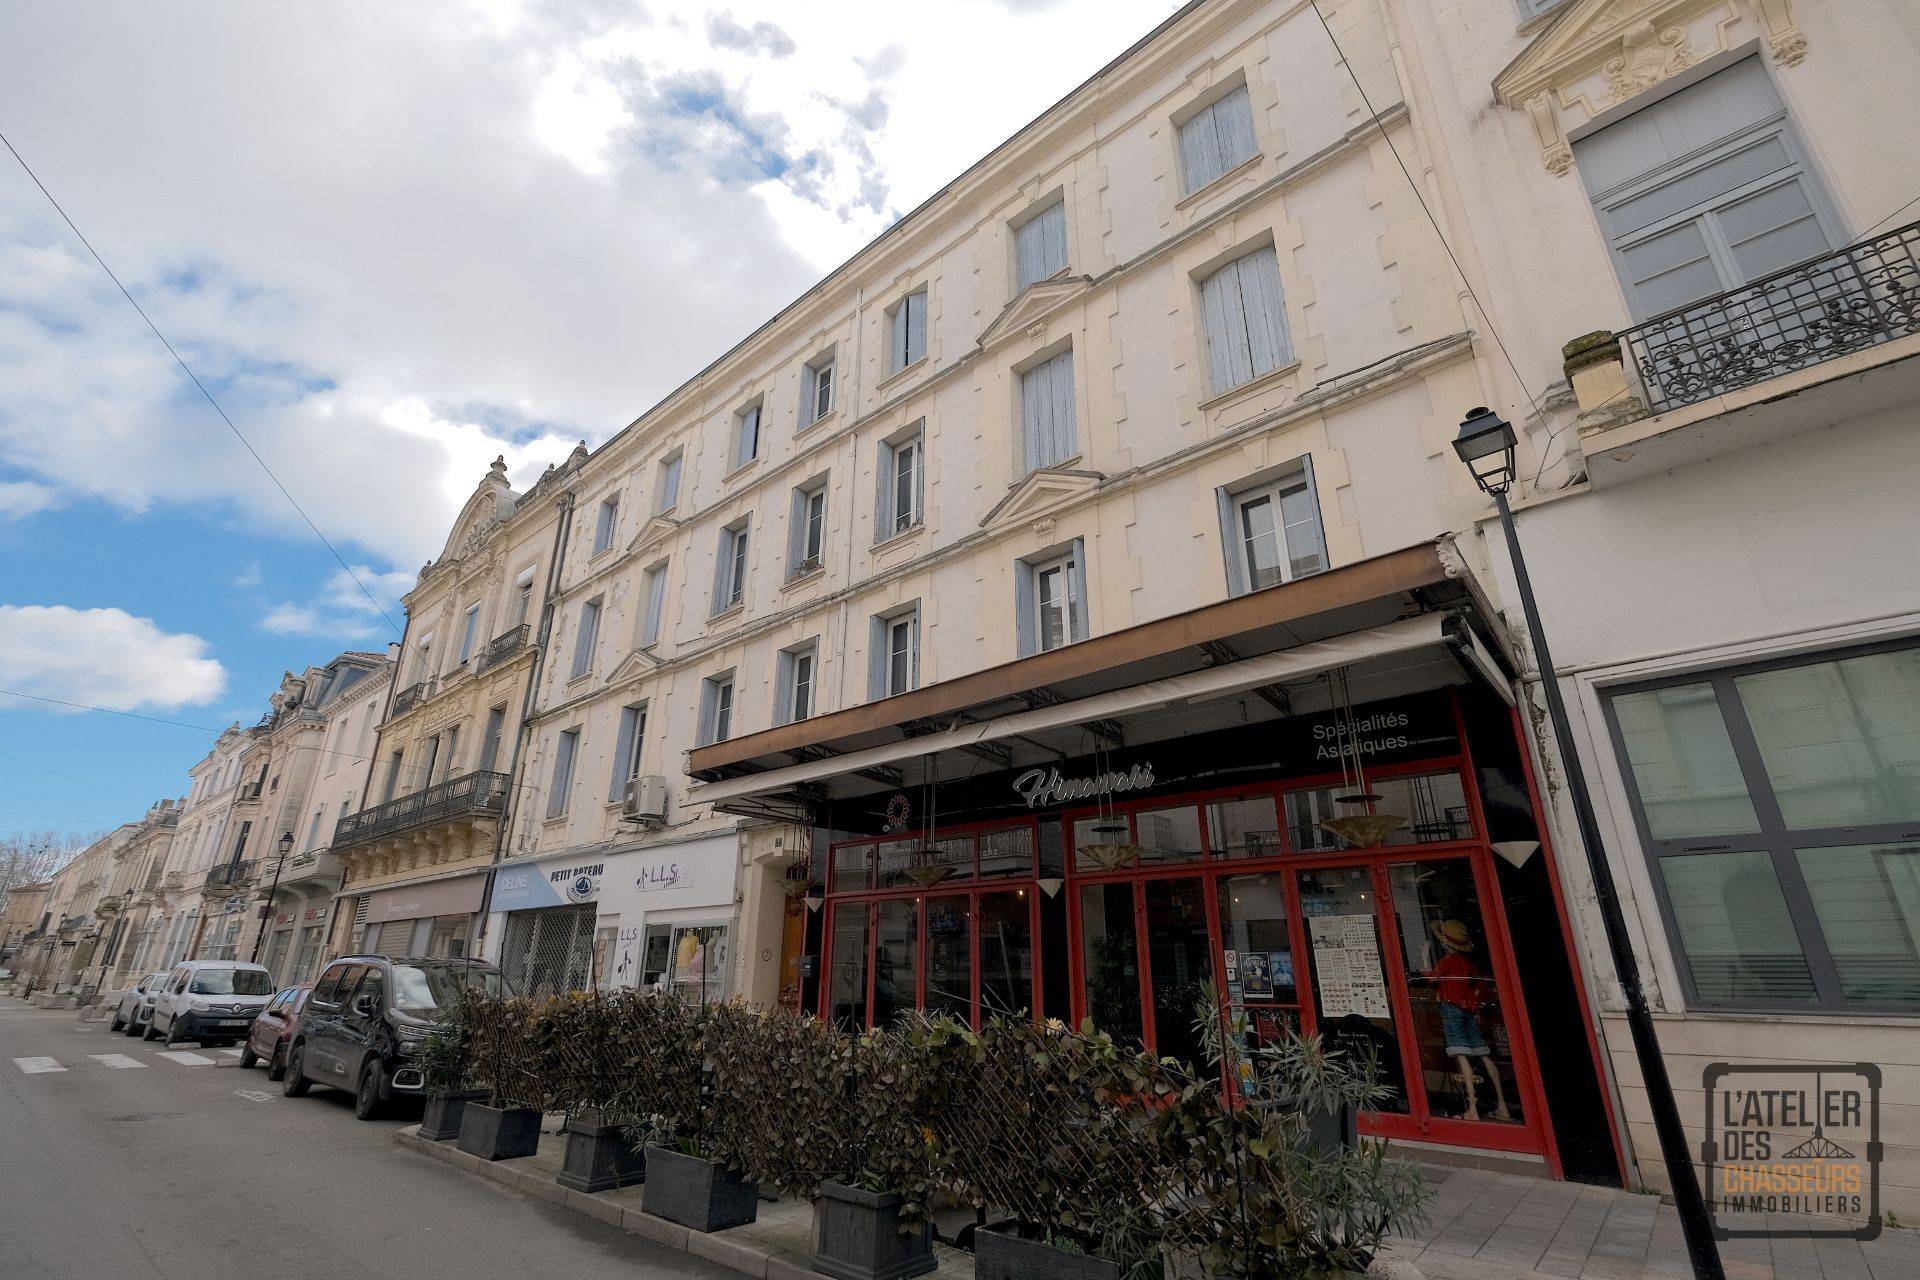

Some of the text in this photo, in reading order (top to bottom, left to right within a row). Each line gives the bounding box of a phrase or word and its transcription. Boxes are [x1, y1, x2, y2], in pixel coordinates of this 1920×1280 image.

[1313, 712, 1409, 741] Spécialités
[1012, 761, 1155, 808] Himawari
[551, 869, 572, 882] PETIT
